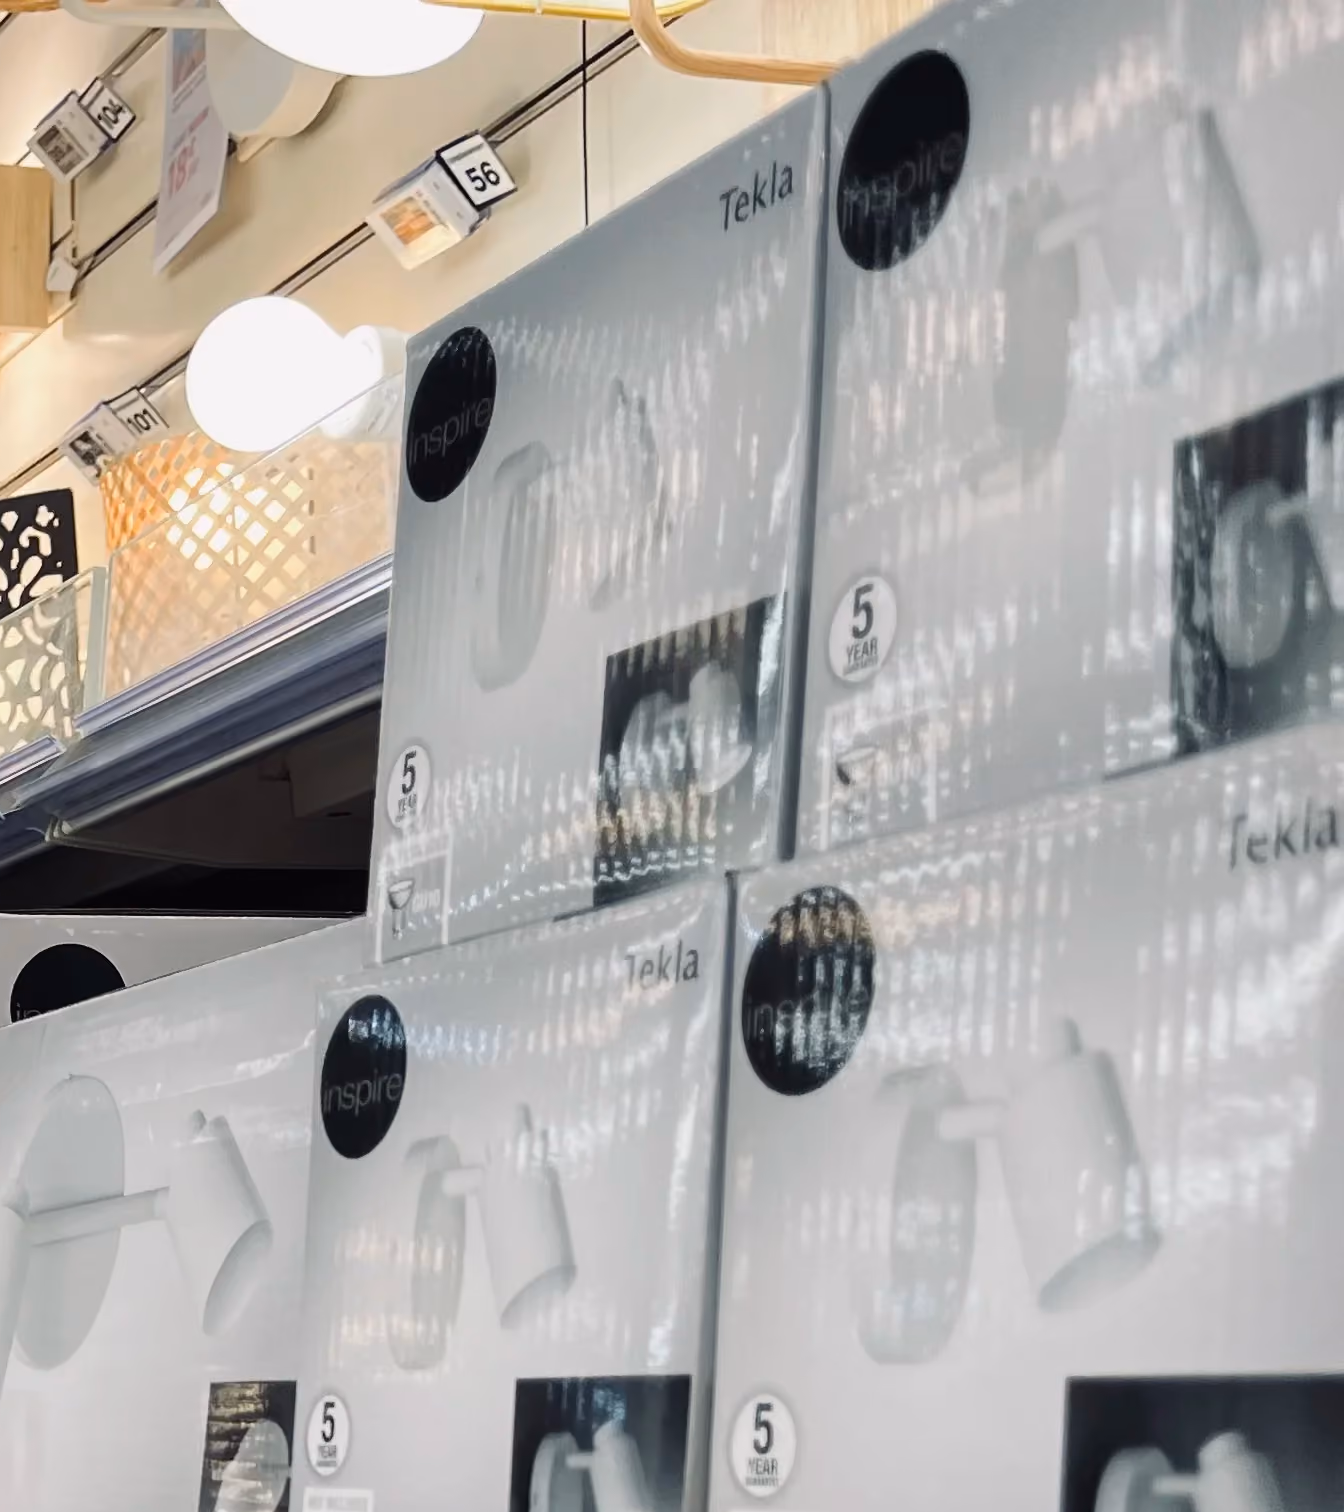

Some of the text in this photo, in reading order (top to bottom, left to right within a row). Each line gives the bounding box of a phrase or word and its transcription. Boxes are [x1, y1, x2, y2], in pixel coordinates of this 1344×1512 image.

[467, 161, 501, 193] 56
[719, 160, 794, 232] Tekla
[852, 583, 874, 639] 5
[402, 749, 418, 795] 5
[1228, 797, 1340, 873] Tekla
[624, 939, 700, 988] Tekla
[323, 1067, 403, 1117] inspire
[321, 1401, 336, 1443] 5
[753, 1402, 774, 1455] 5
